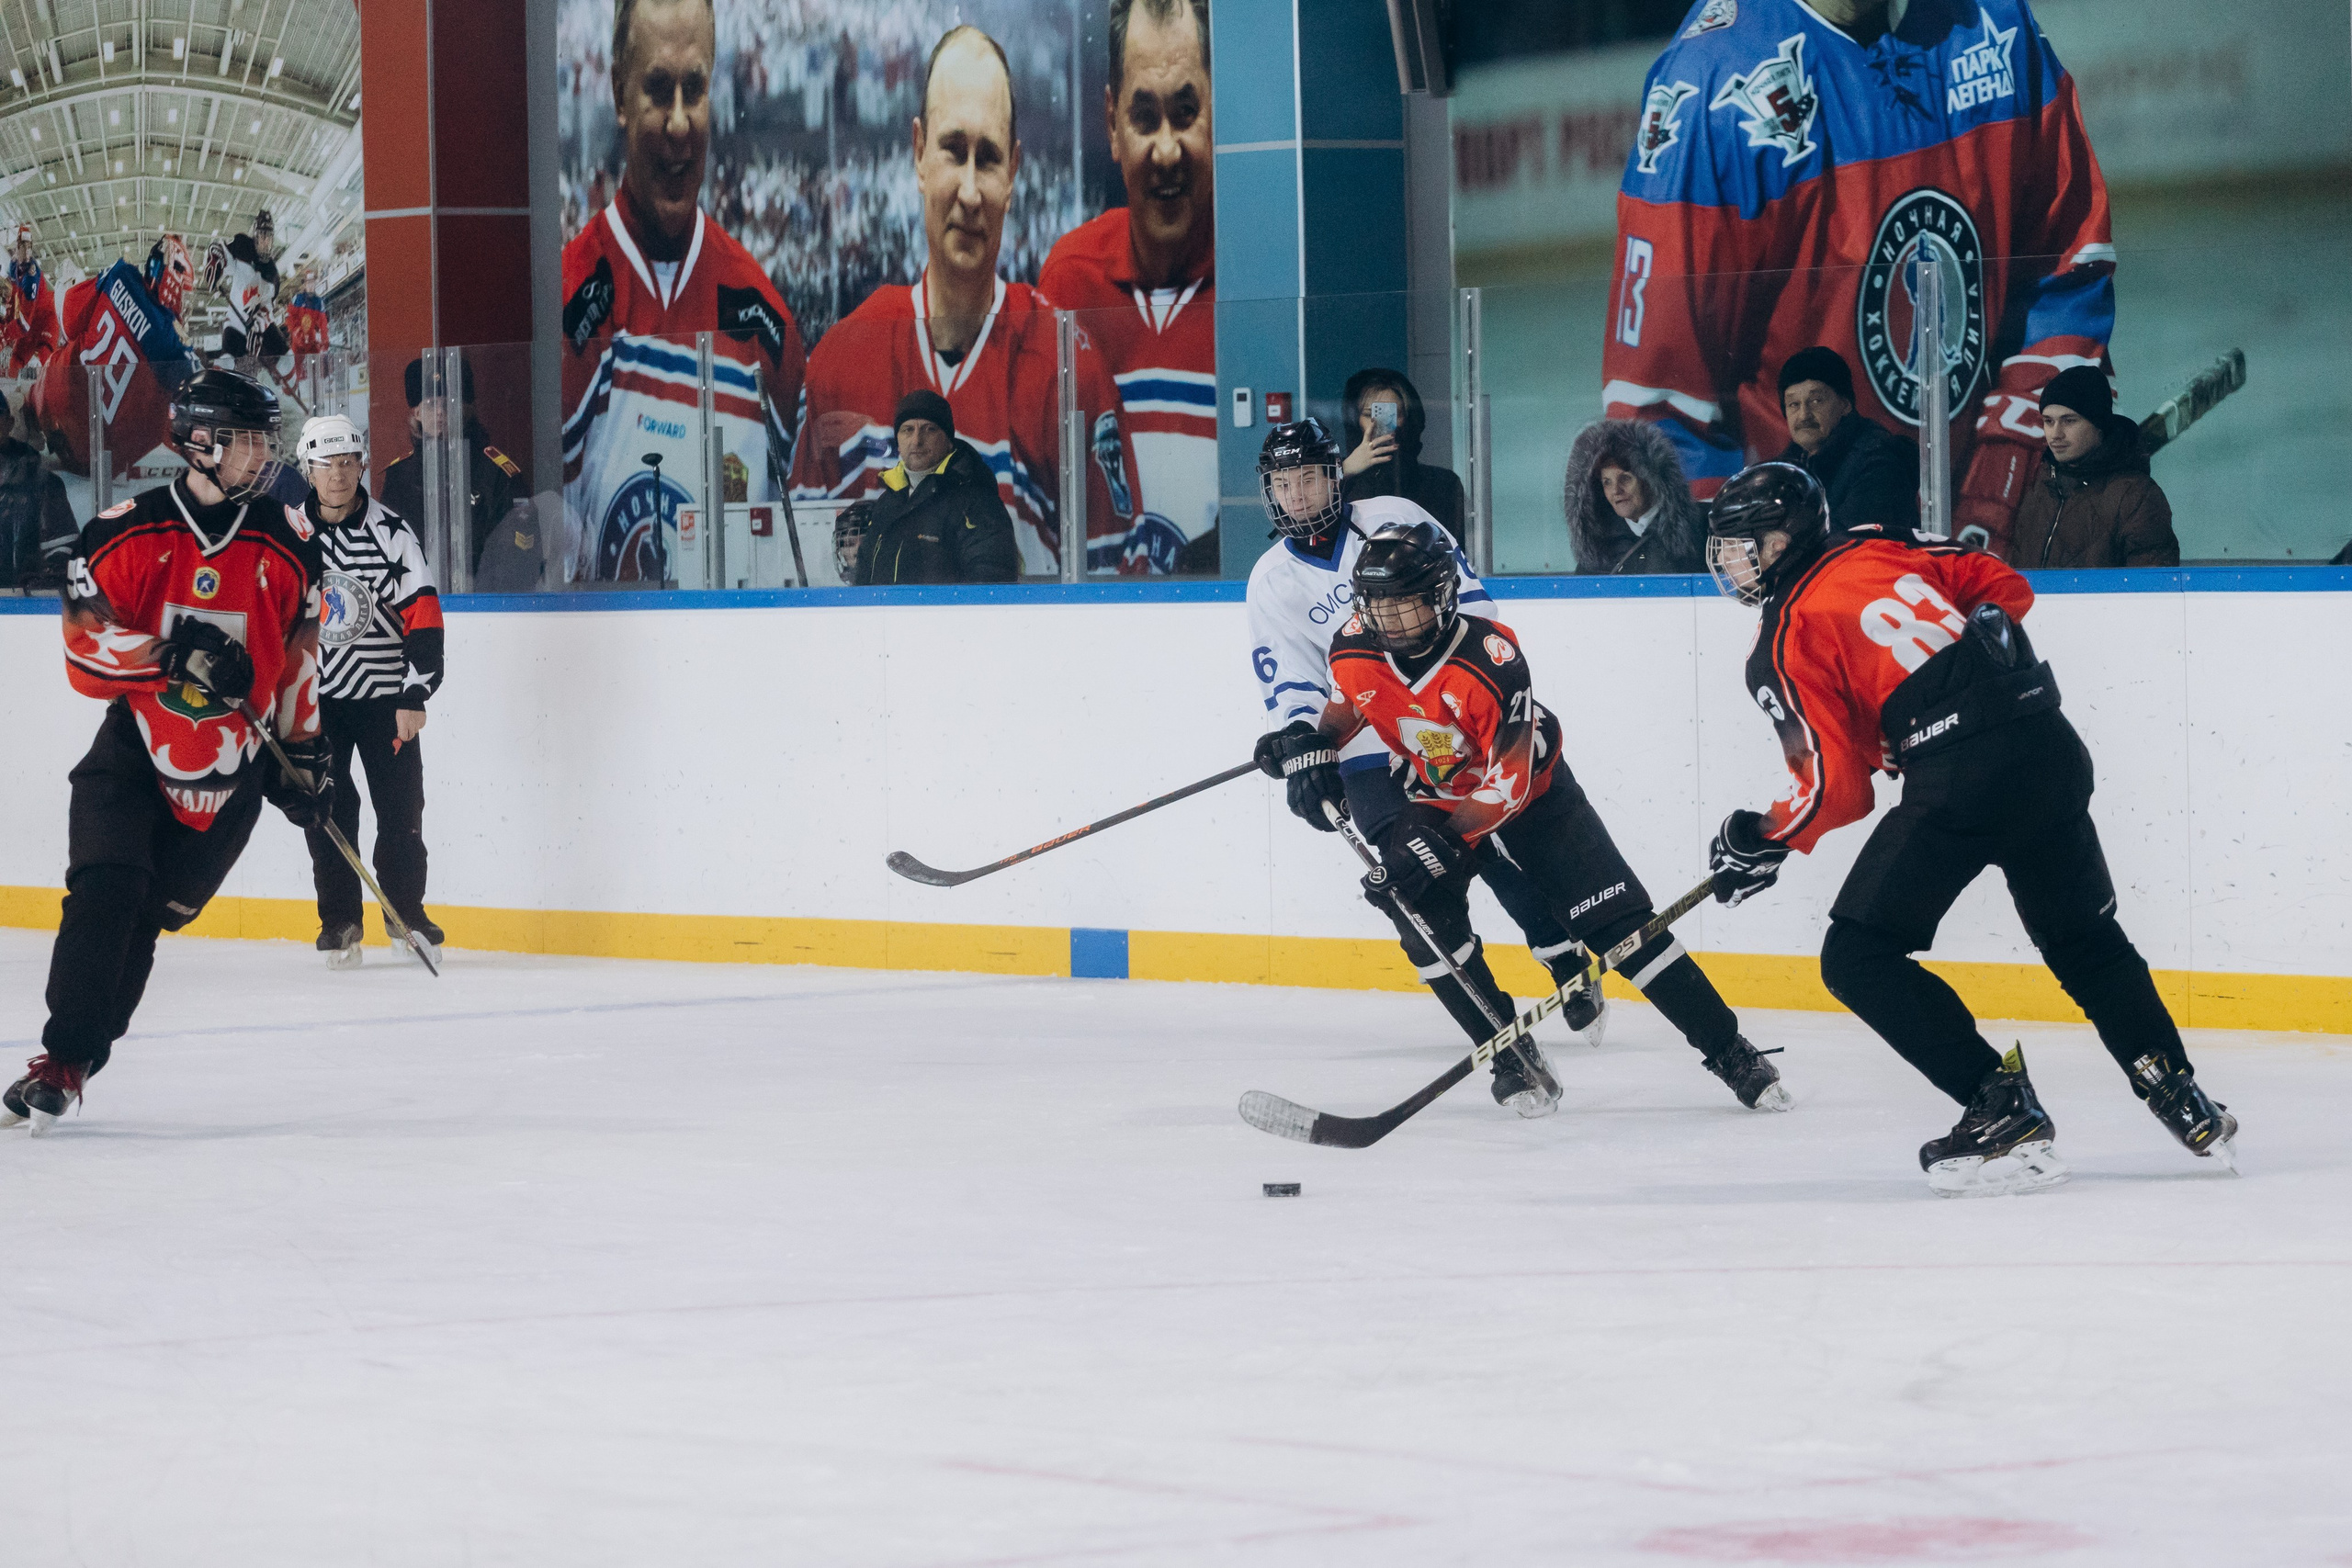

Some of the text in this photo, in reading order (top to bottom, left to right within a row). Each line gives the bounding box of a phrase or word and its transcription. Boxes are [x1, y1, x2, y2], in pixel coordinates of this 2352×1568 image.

[1951, 45, 2004, 84] ПАРК
[1947, 70, 2015, 115] ЛЕГЕНД
[1883, 205, 1963, 263] НОЧНАЯ
[109, 278, 152, 342] GUSKOV
[1963, 282, 1980, 370] ЛИГА
[80, 310, 139, 424] 29
[1866, 310, 1962, 412] ХОККЕЯ
[1274, 448, 1300, 457] CCM
[617, 489, 677, 535] НОЧН
[325, 577, 357, 592] ЧНАЯ
[1308, 579, 1355, 625] ОМС
[319, 627, 353, 640] ЕЙНАЯ
[355, 603, 368, 630] ЛИГА
[1860, 573, 1967, 674] 83
[1251, 646, 1278, 683] 6
[1508, 686, 1532, 724] 21
[1901, 713, 1960, 751] BAUER
[1031, 825, 1091, 854] BAUER
[1569, 882, 1626, 919] BAUER
[1412, 913, 1434, 936] BAUER
[1471, 973, 1585, 1071] BAUER
[1984, 1114, 2012, 1135] BAUER
